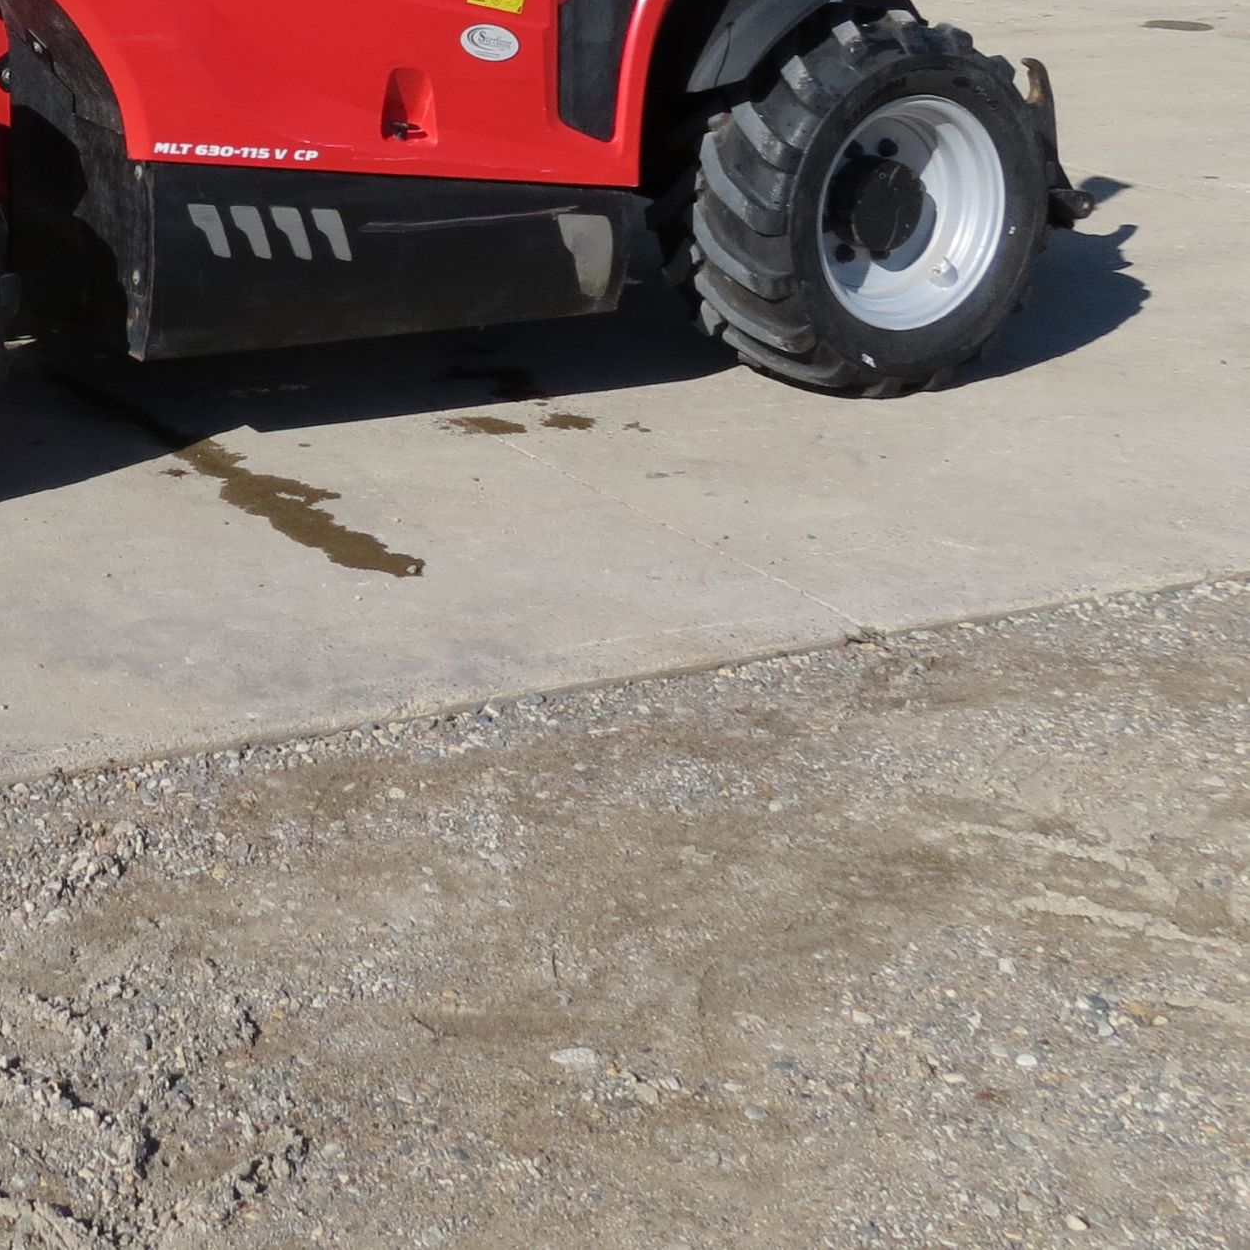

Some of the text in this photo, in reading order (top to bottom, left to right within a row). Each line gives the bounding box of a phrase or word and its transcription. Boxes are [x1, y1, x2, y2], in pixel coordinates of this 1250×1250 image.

[153, 142, 319, 161] MLT 630-115 V CP
